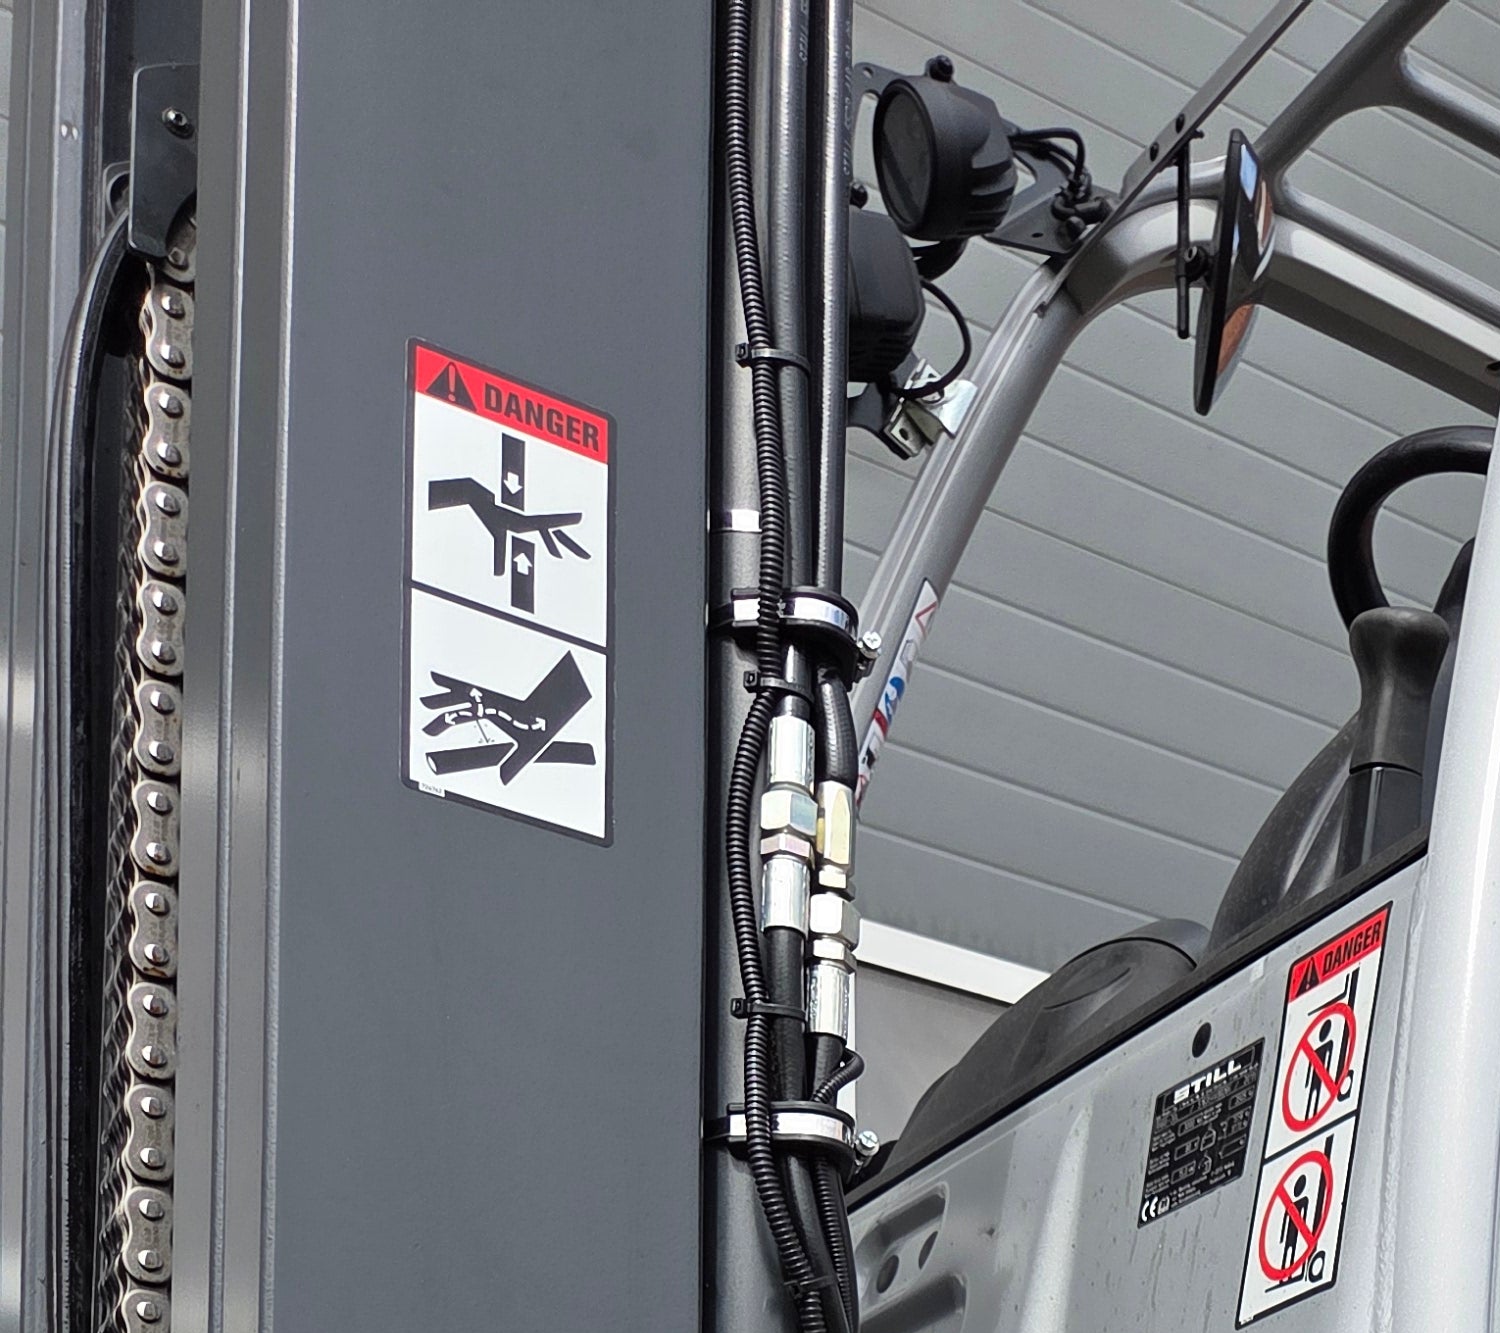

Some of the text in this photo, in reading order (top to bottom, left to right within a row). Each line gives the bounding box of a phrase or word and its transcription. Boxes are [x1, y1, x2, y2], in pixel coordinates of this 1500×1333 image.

[484, 382, 599, 453] DANGER
[1321, 919, 1383, 977] DANGER
[1173, 1060, 1243, 1105] STILL
